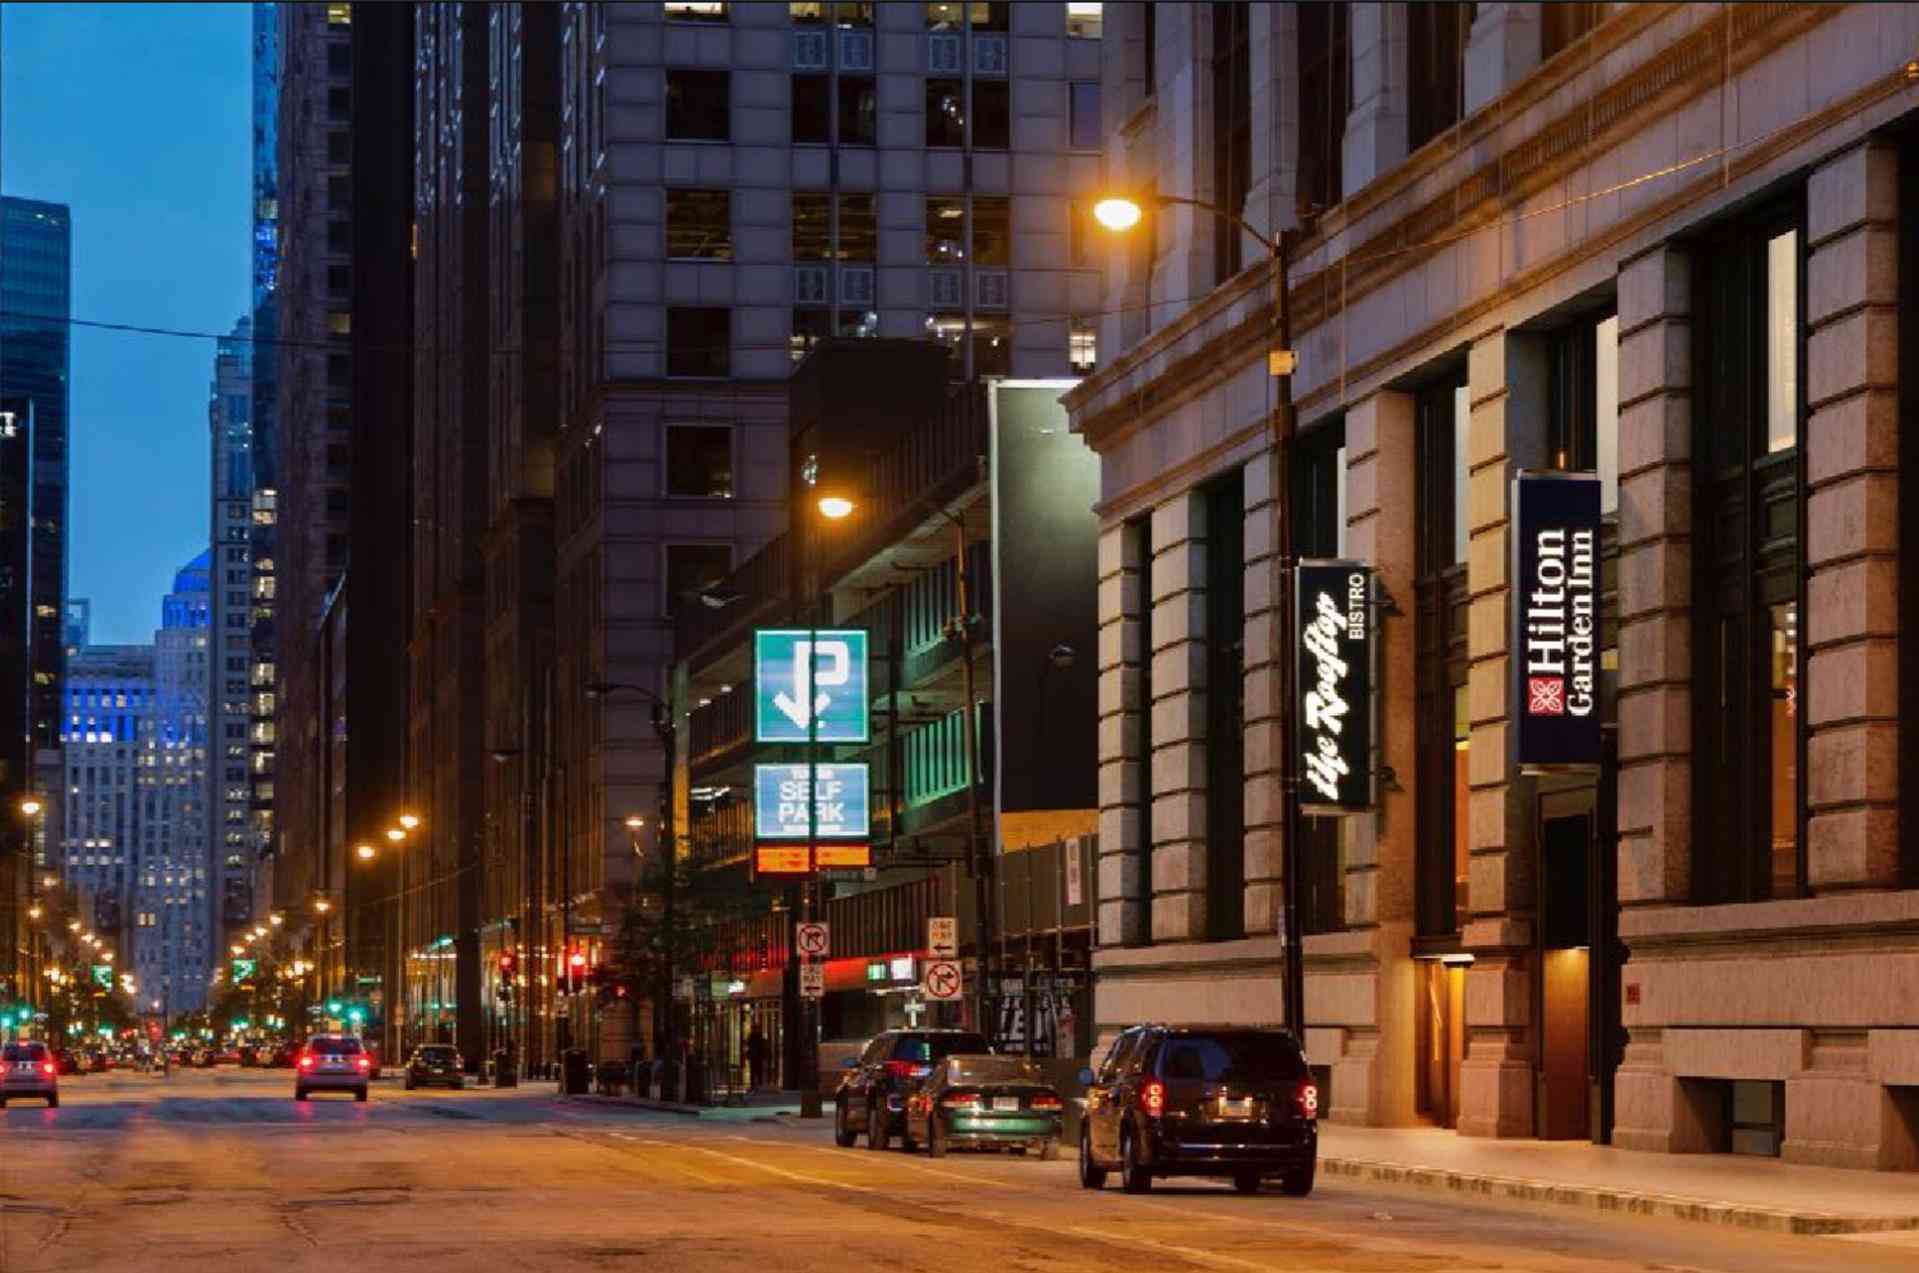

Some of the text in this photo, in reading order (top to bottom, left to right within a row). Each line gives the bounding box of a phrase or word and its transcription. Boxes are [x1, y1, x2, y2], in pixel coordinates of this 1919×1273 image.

[1348, 573, 1364, 640] BISTRO
[1528, 529, 1565, 674] Hilton
[1567, 529, 1593, 716] Garden Inn
[1304, 591, 1349, 735] Rooftop
[778, 781, 842, 801] SELF
[778, 803, 845, 823] PARK
